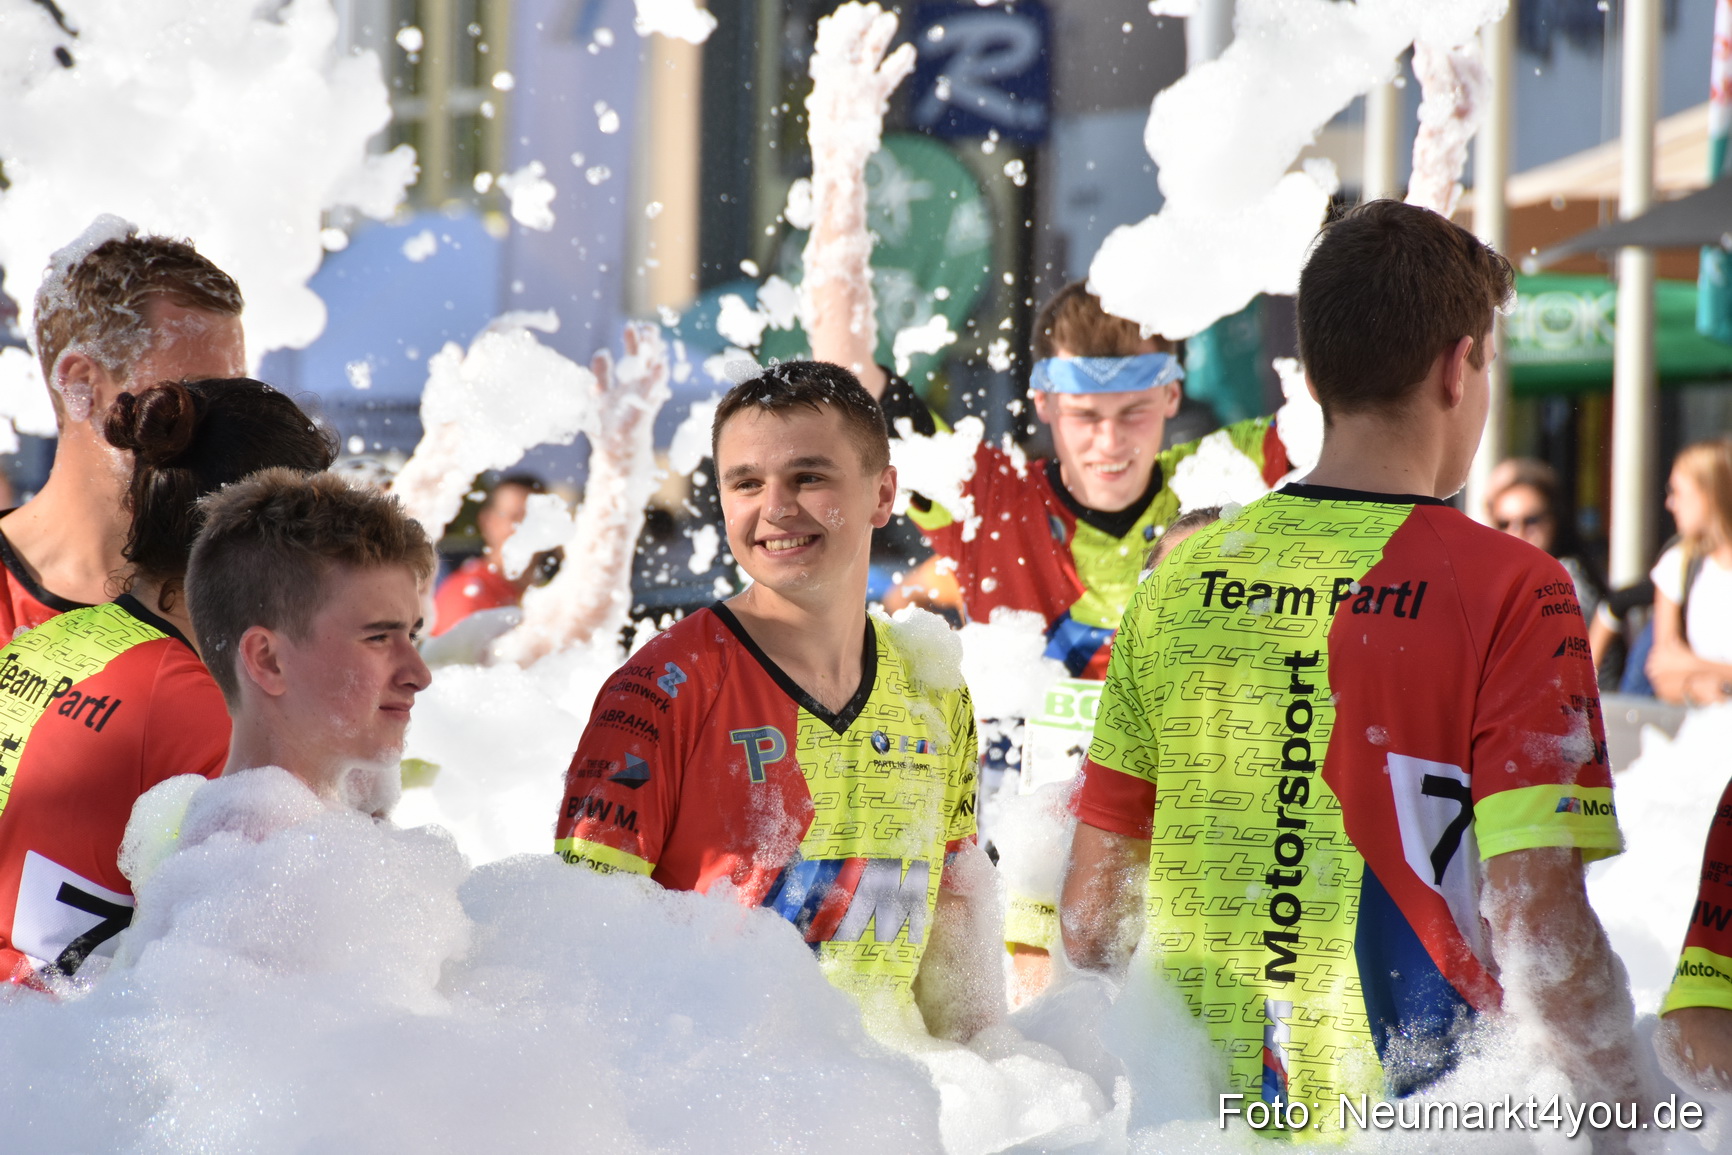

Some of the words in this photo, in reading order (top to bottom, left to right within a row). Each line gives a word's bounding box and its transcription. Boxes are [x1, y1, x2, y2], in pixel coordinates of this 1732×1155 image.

[1200, 569, 1314, 616] Team
[1328, 577, 1428, 620] Partl
[0, 652, 48, 706] Team
[42, 676, 122, 733] Partl
[1263, 650, 1320, 983] Motorsport
[1420, 773, 1474, 887] 7
[55, 881, 135, 977] 7
